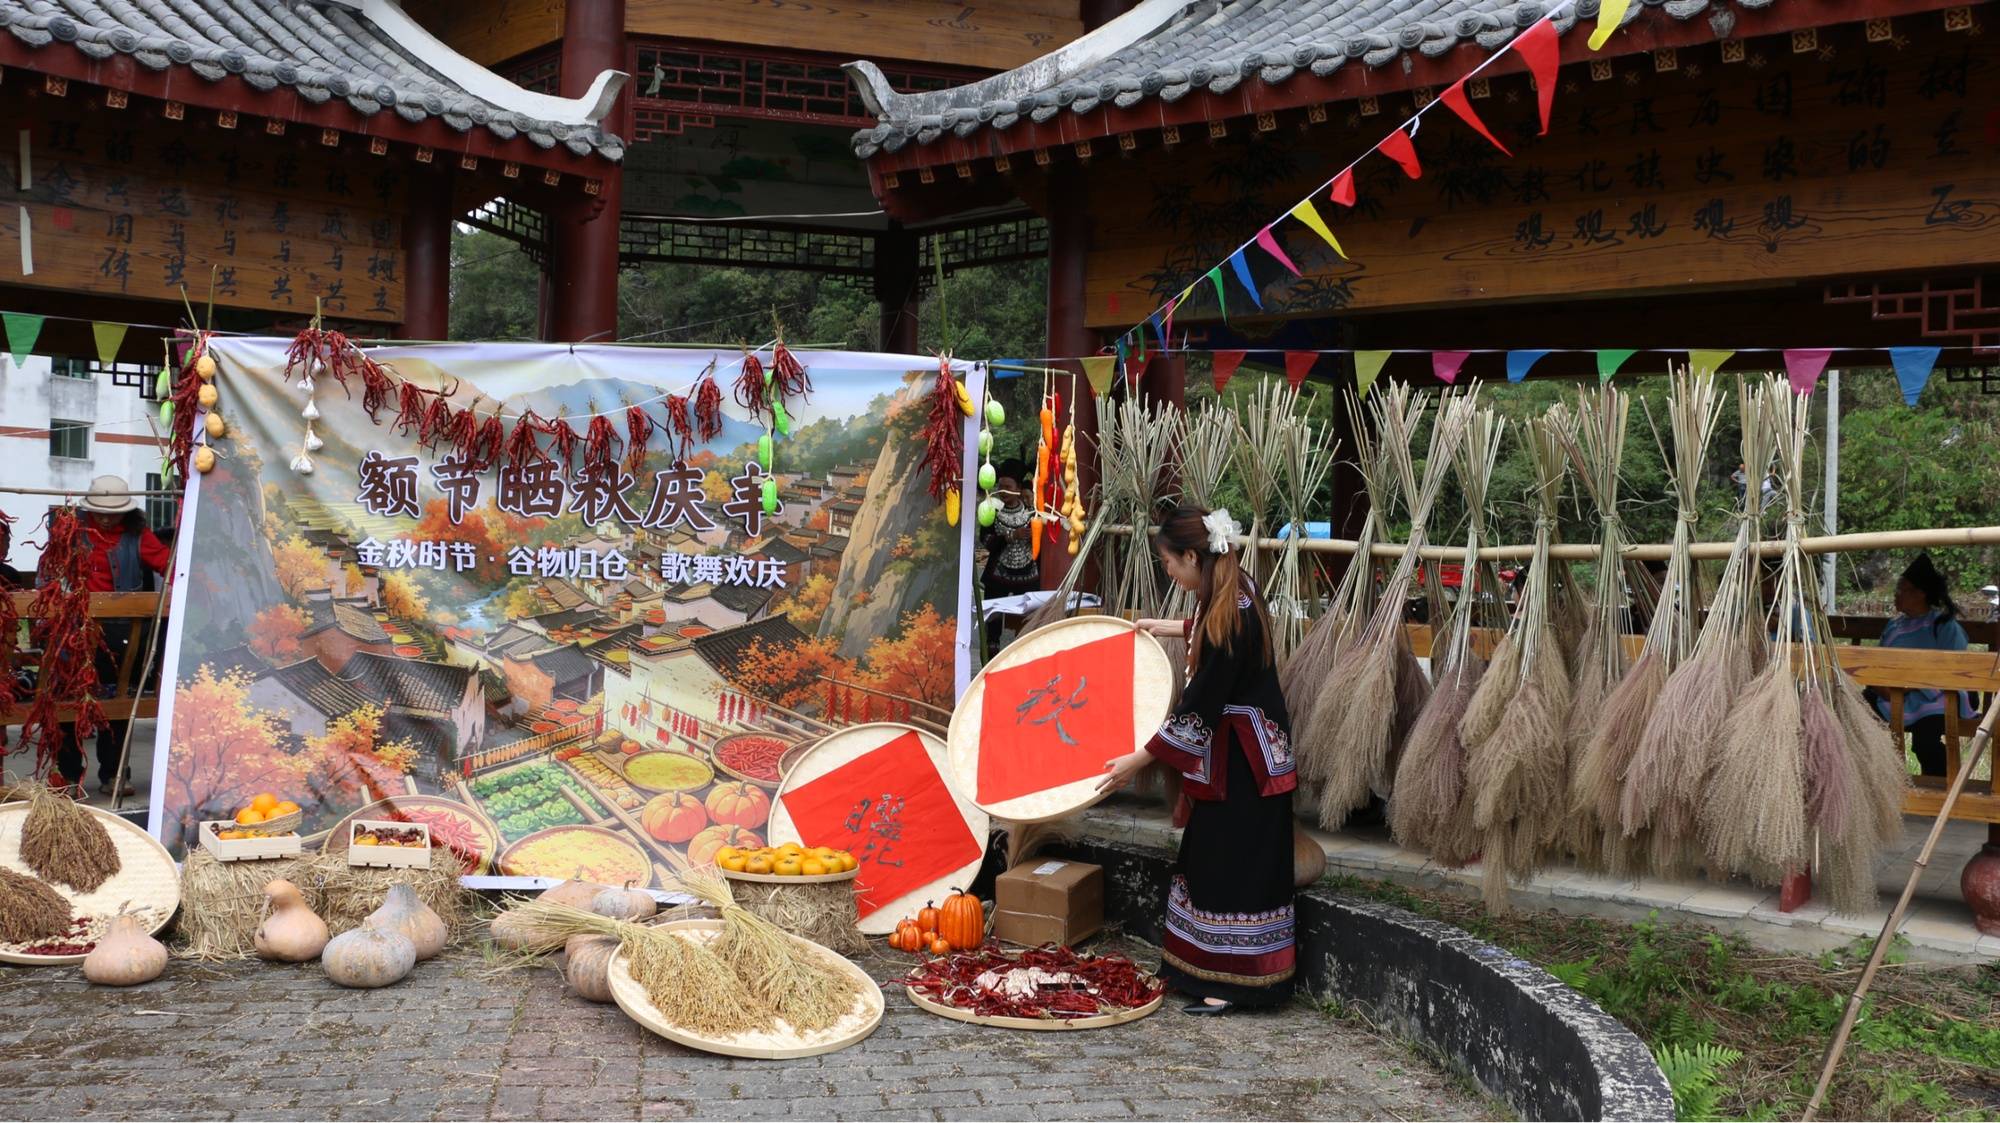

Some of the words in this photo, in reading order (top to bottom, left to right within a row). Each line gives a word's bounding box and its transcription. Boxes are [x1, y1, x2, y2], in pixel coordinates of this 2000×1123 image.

[356, 450, 784, 537] 额节晒秋庆丰
[1016, 674, 1088, 746] 秋
